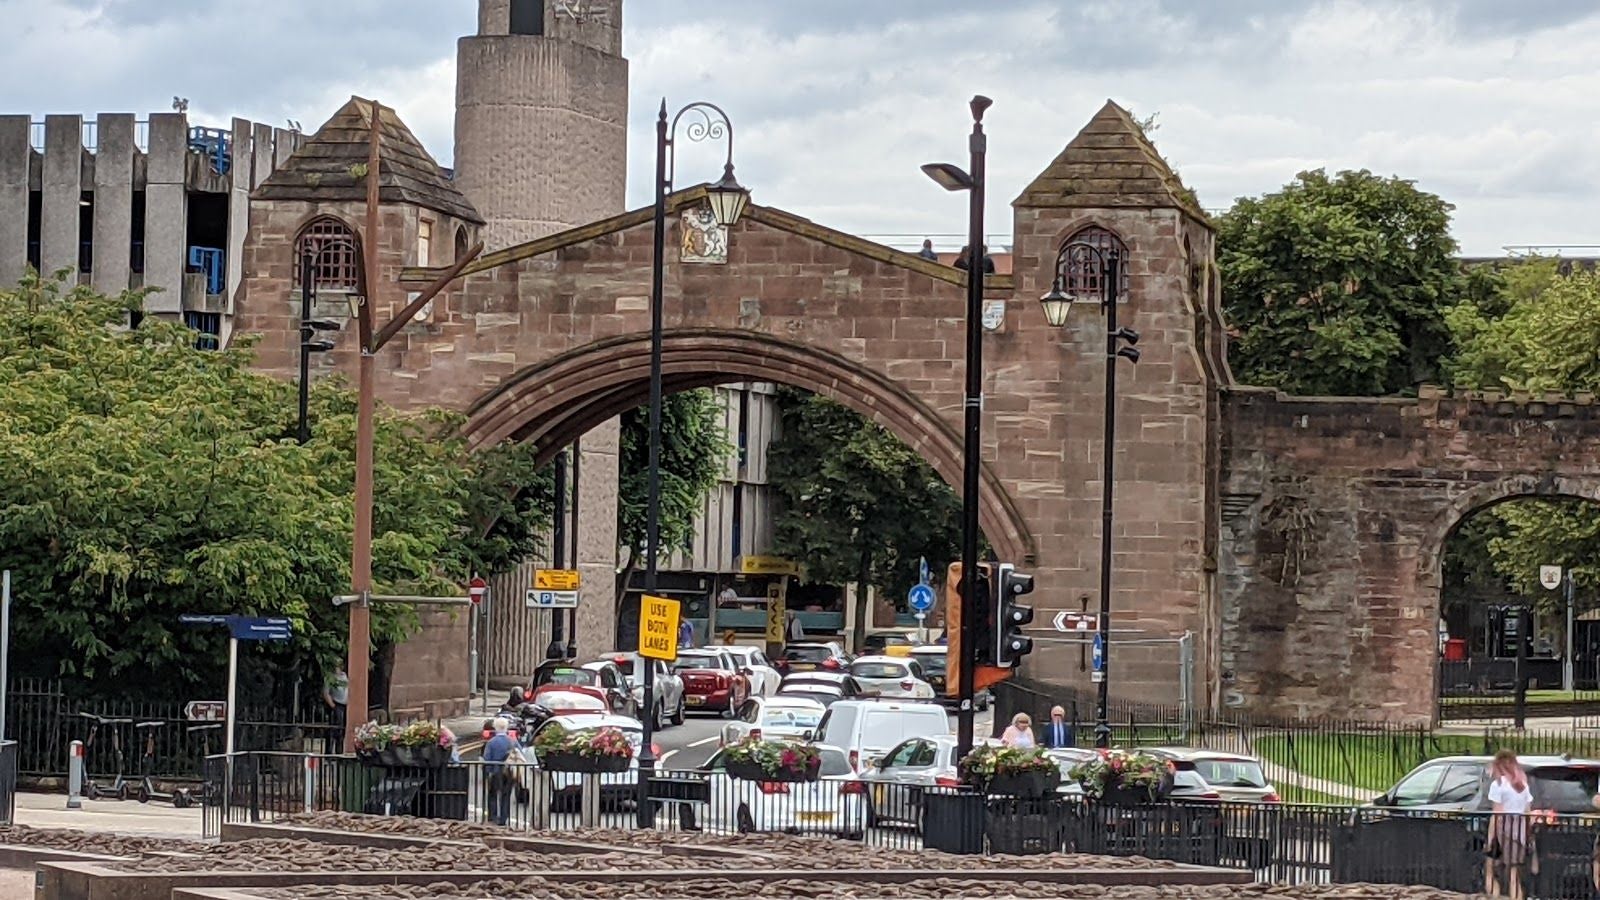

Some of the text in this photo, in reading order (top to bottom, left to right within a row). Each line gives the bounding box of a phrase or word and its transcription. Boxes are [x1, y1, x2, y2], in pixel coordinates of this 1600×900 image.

[650, 603, 668, 617] USE
[647, 618, 670, 635] BOTH
[644, 636, 670, 652] LANES
